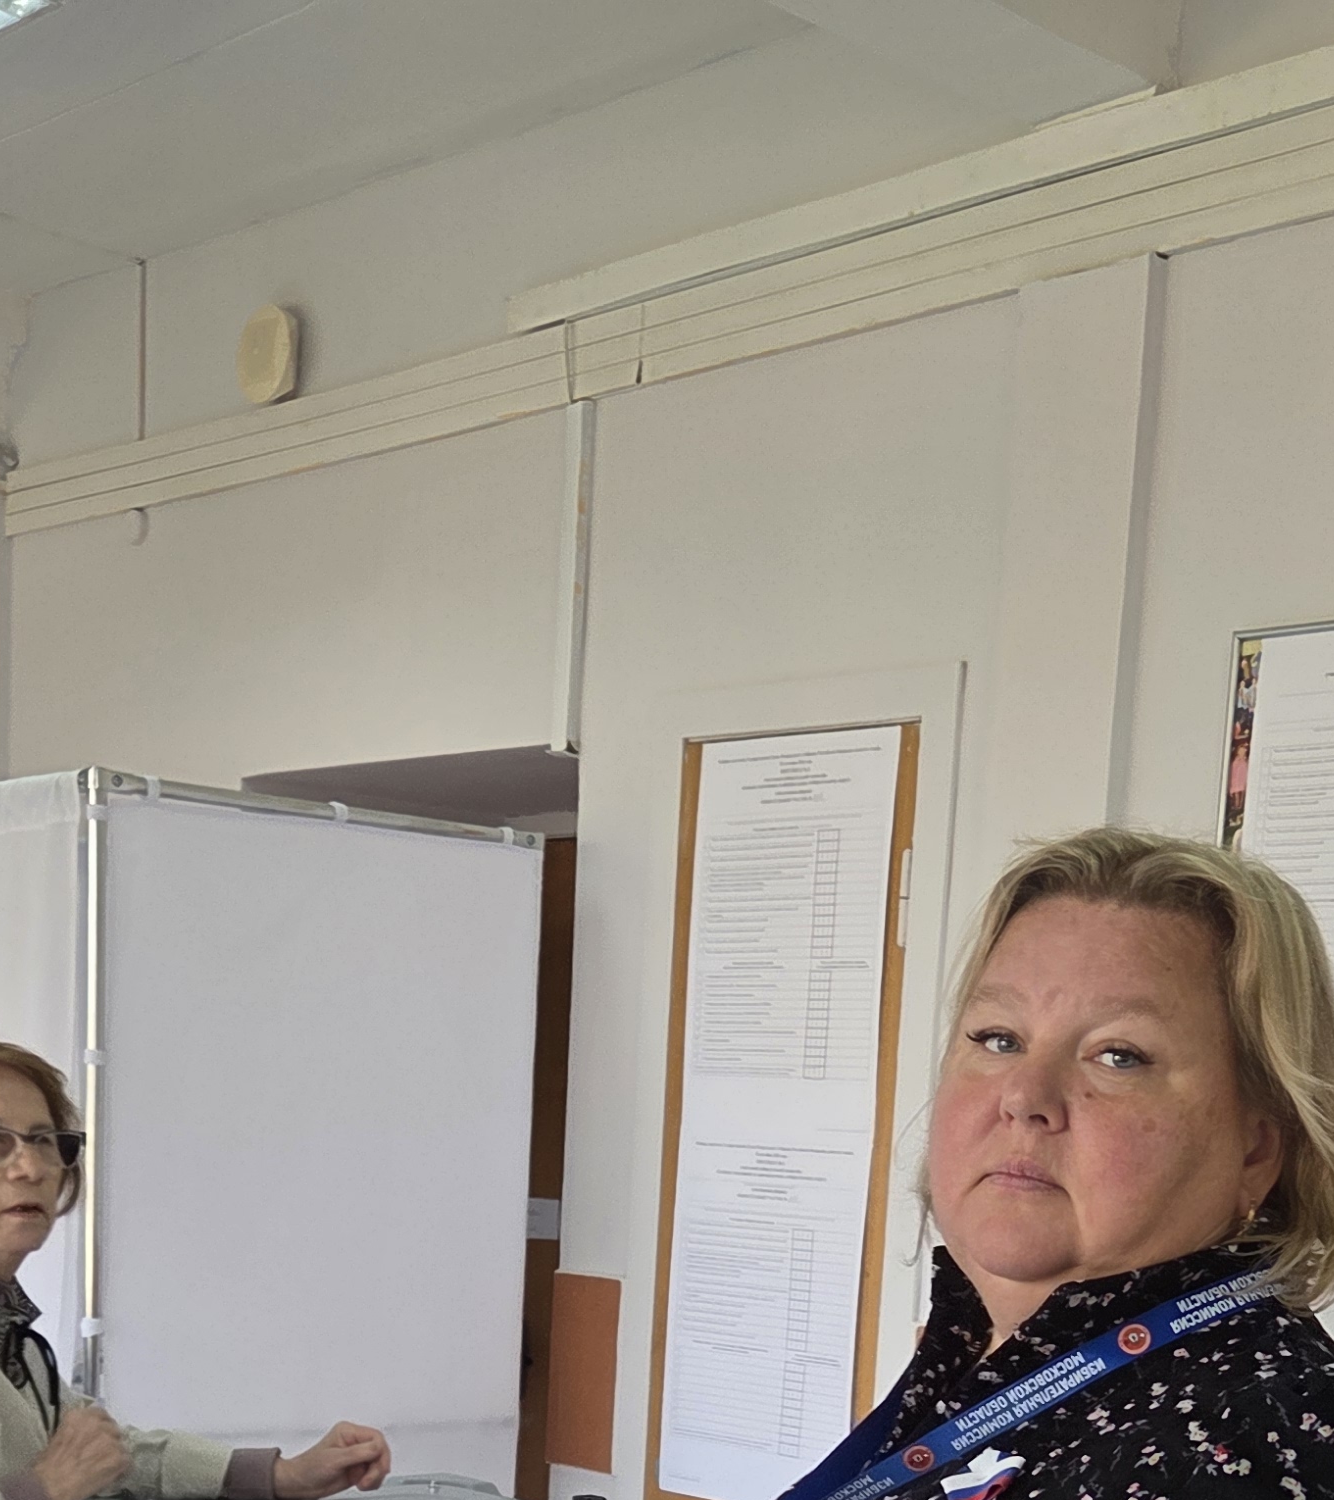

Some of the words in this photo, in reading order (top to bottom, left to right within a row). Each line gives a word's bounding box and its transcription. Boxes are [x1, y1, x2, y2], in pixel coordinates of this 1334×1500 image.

[1169, 1298, 1237, 1334] КОМИССИЯ
[1175, 1284, 1230, 1313] ОБЛАСТИ
[1004, 1351, 1086, 1404] МОСКОВСКОЙ
[1015, 1356, 1107, 1418] ИЗБИРАТЕЛЬНАЯ
[950, 1410, 1016, 1451] КОМИССИЯ
[954, 1397, 1009, 1432] ОБЛАСТИ
